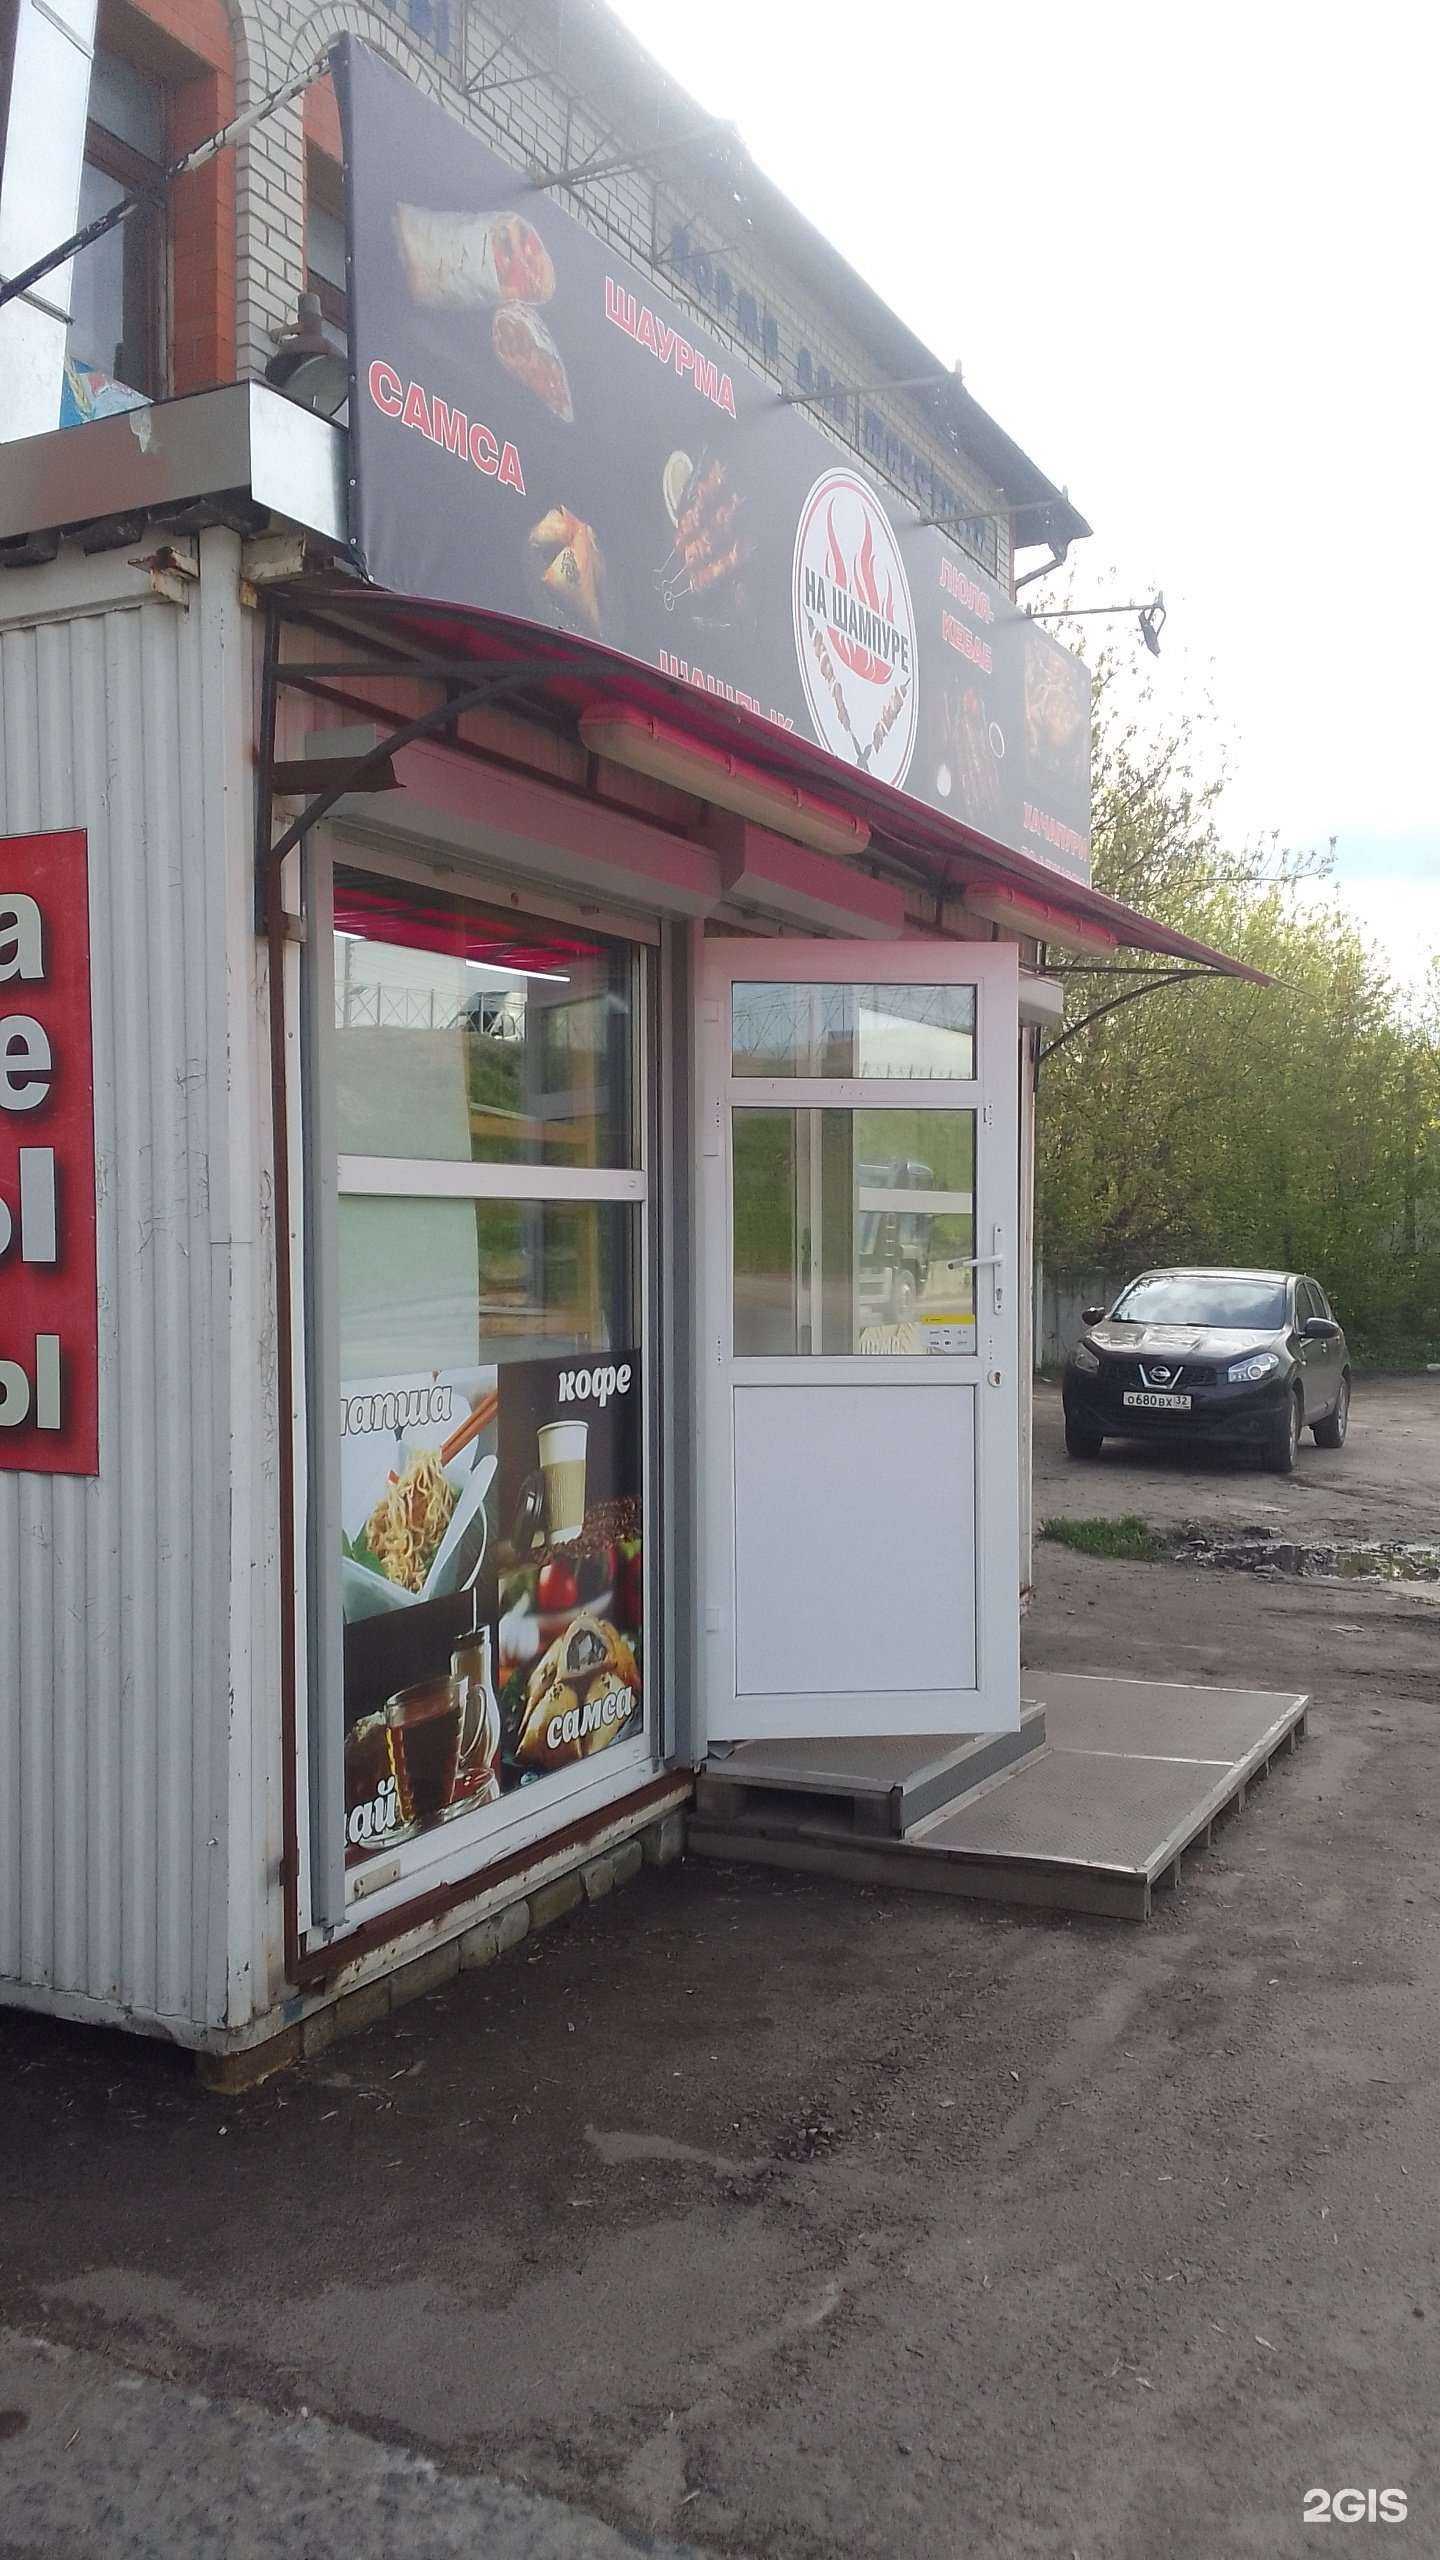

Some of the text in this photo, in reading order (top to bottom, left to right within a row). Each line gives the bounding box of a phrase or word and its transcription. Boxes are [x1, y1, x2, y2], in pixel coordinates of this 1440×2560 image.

[605, 275, 737, 420] ШАУРМА
[368, 360, 527, 496] САМСА
[805, 566, 909, 675] НА ШАМПУРЕ
[659, 649, 794, 732] ШАШЛ
[558, 1363, 632, 1408] кофе
[546, 1686, 633, 1750] самса
[343, 1775, 396, 1848] ай
